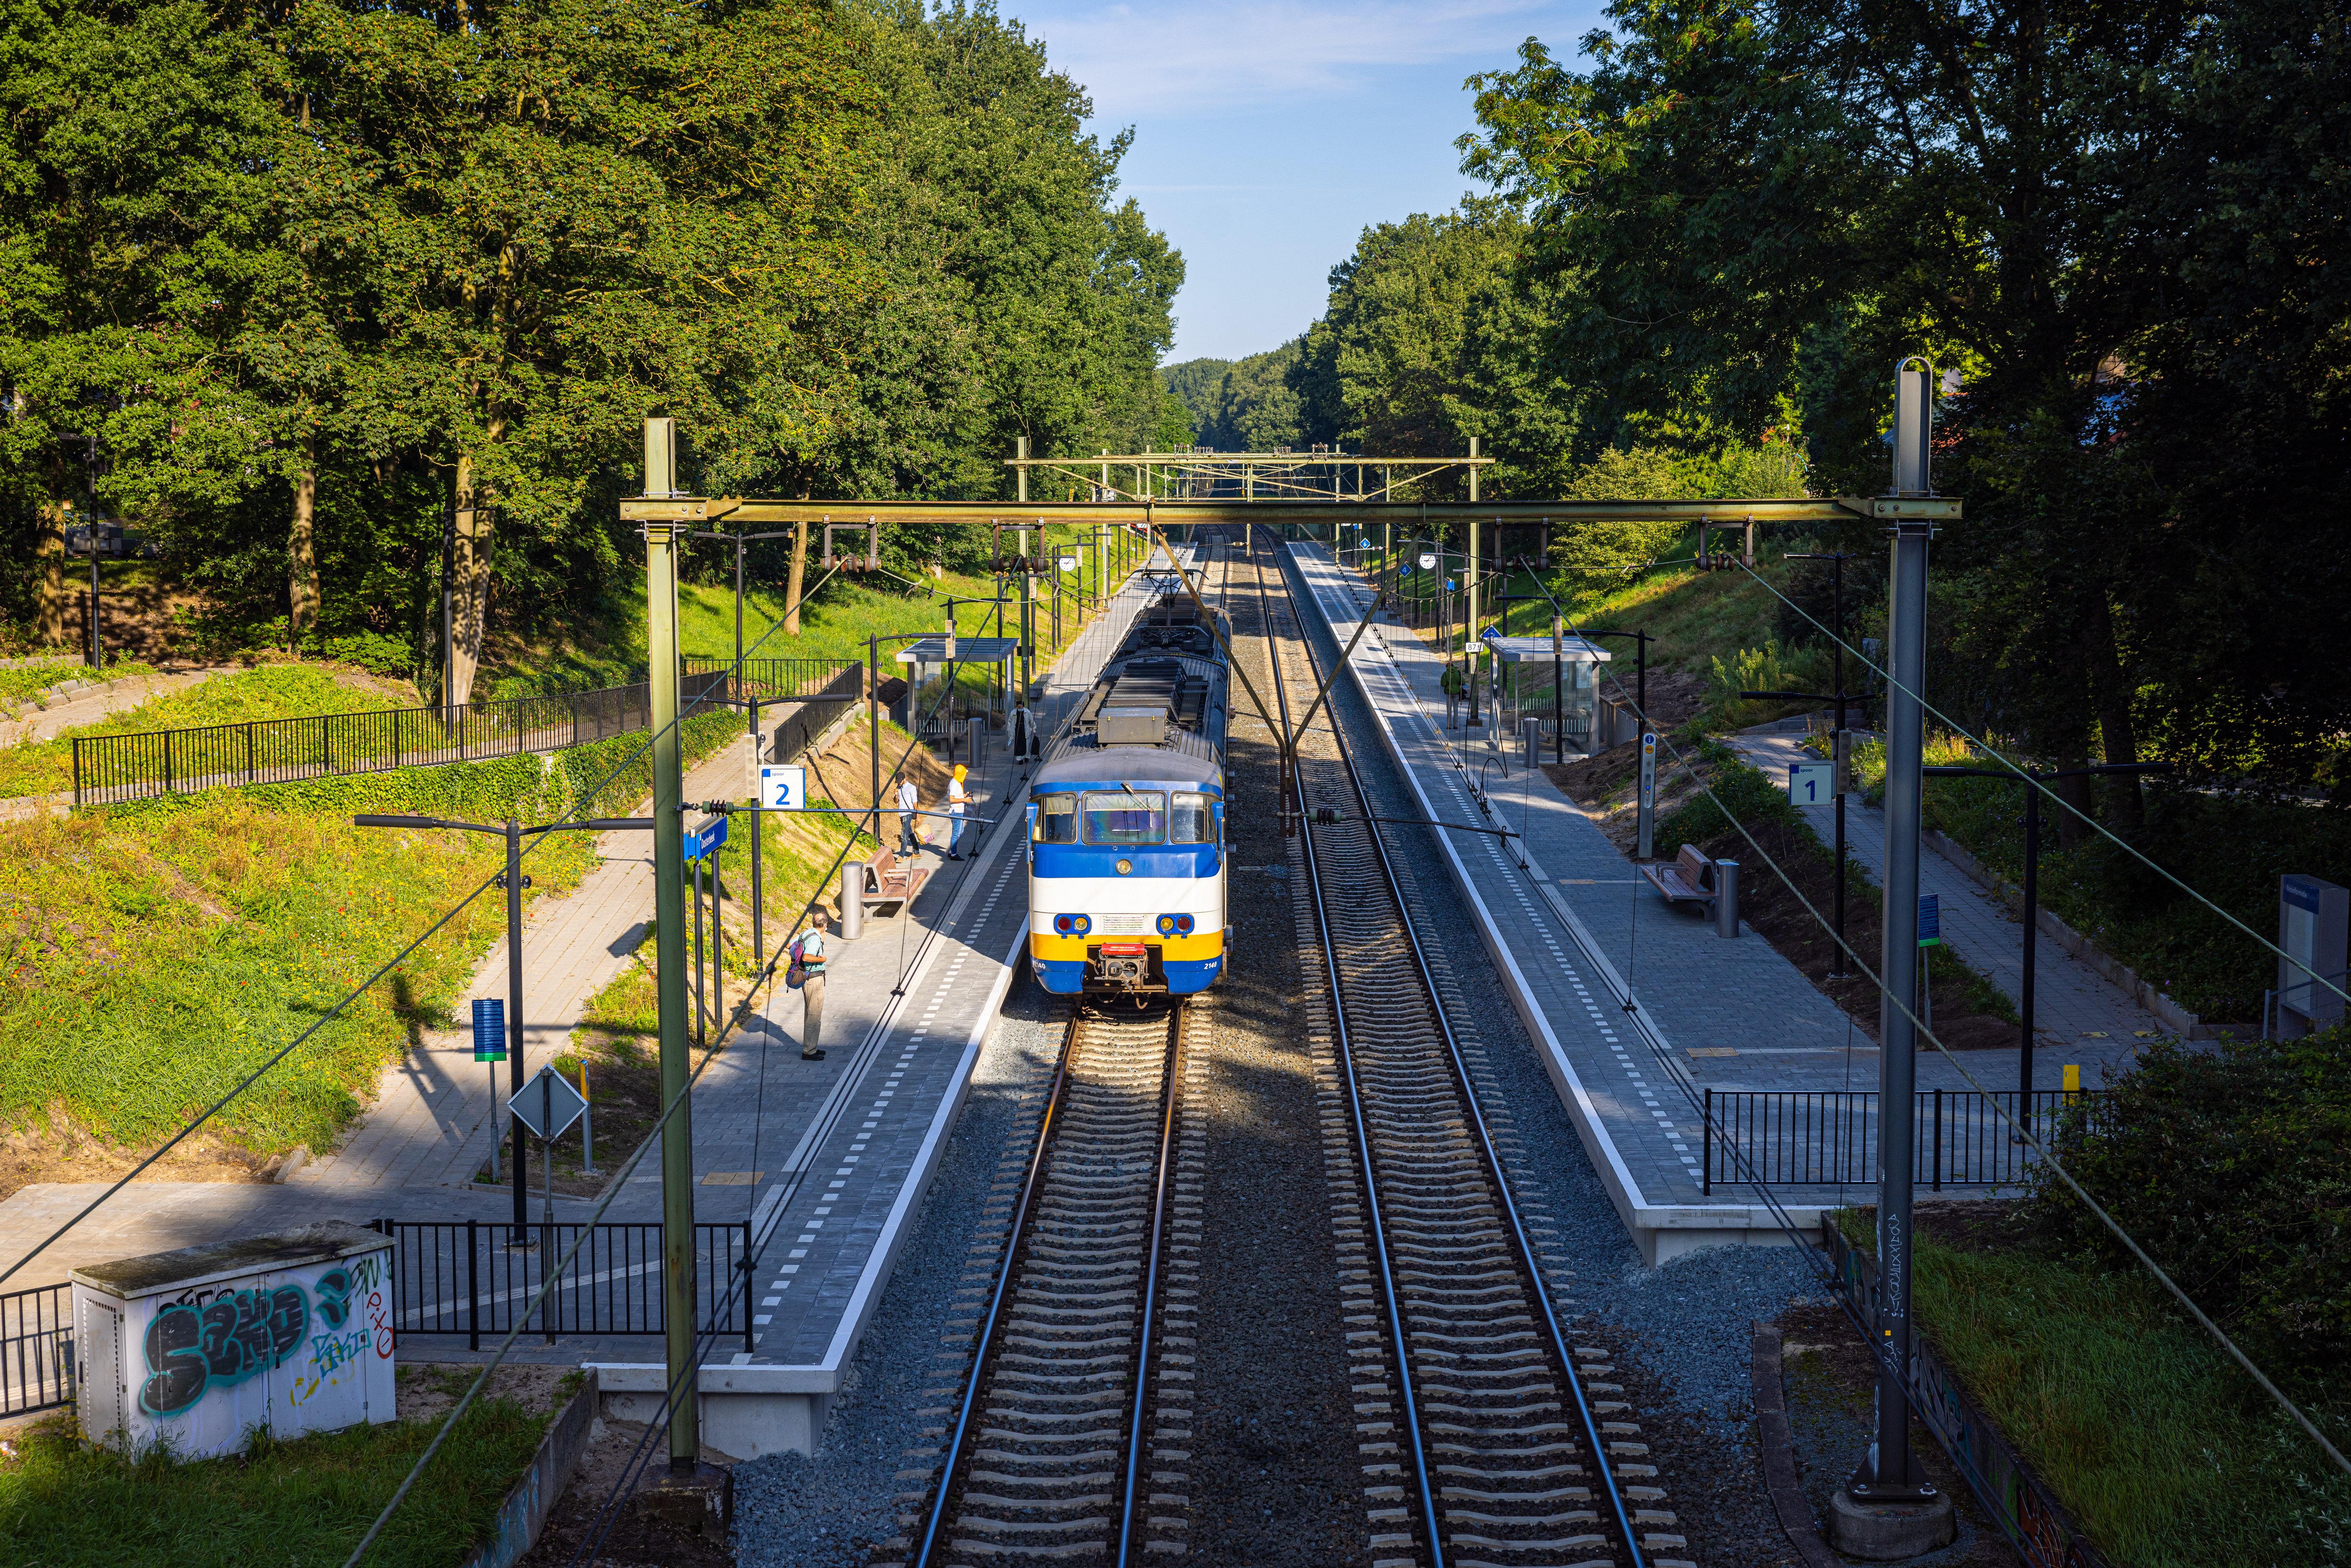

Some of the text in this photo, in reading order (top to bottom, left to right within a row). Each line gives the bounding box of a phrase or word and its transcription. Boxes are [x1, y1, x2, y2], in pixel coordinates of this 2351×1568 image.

[776, 784, 790, 805] 2
[1805, 780, 1815, 801] 1
[701, 830, 715, 849] Oosterbeek
[1204, 961, 1217, 969] 2140
